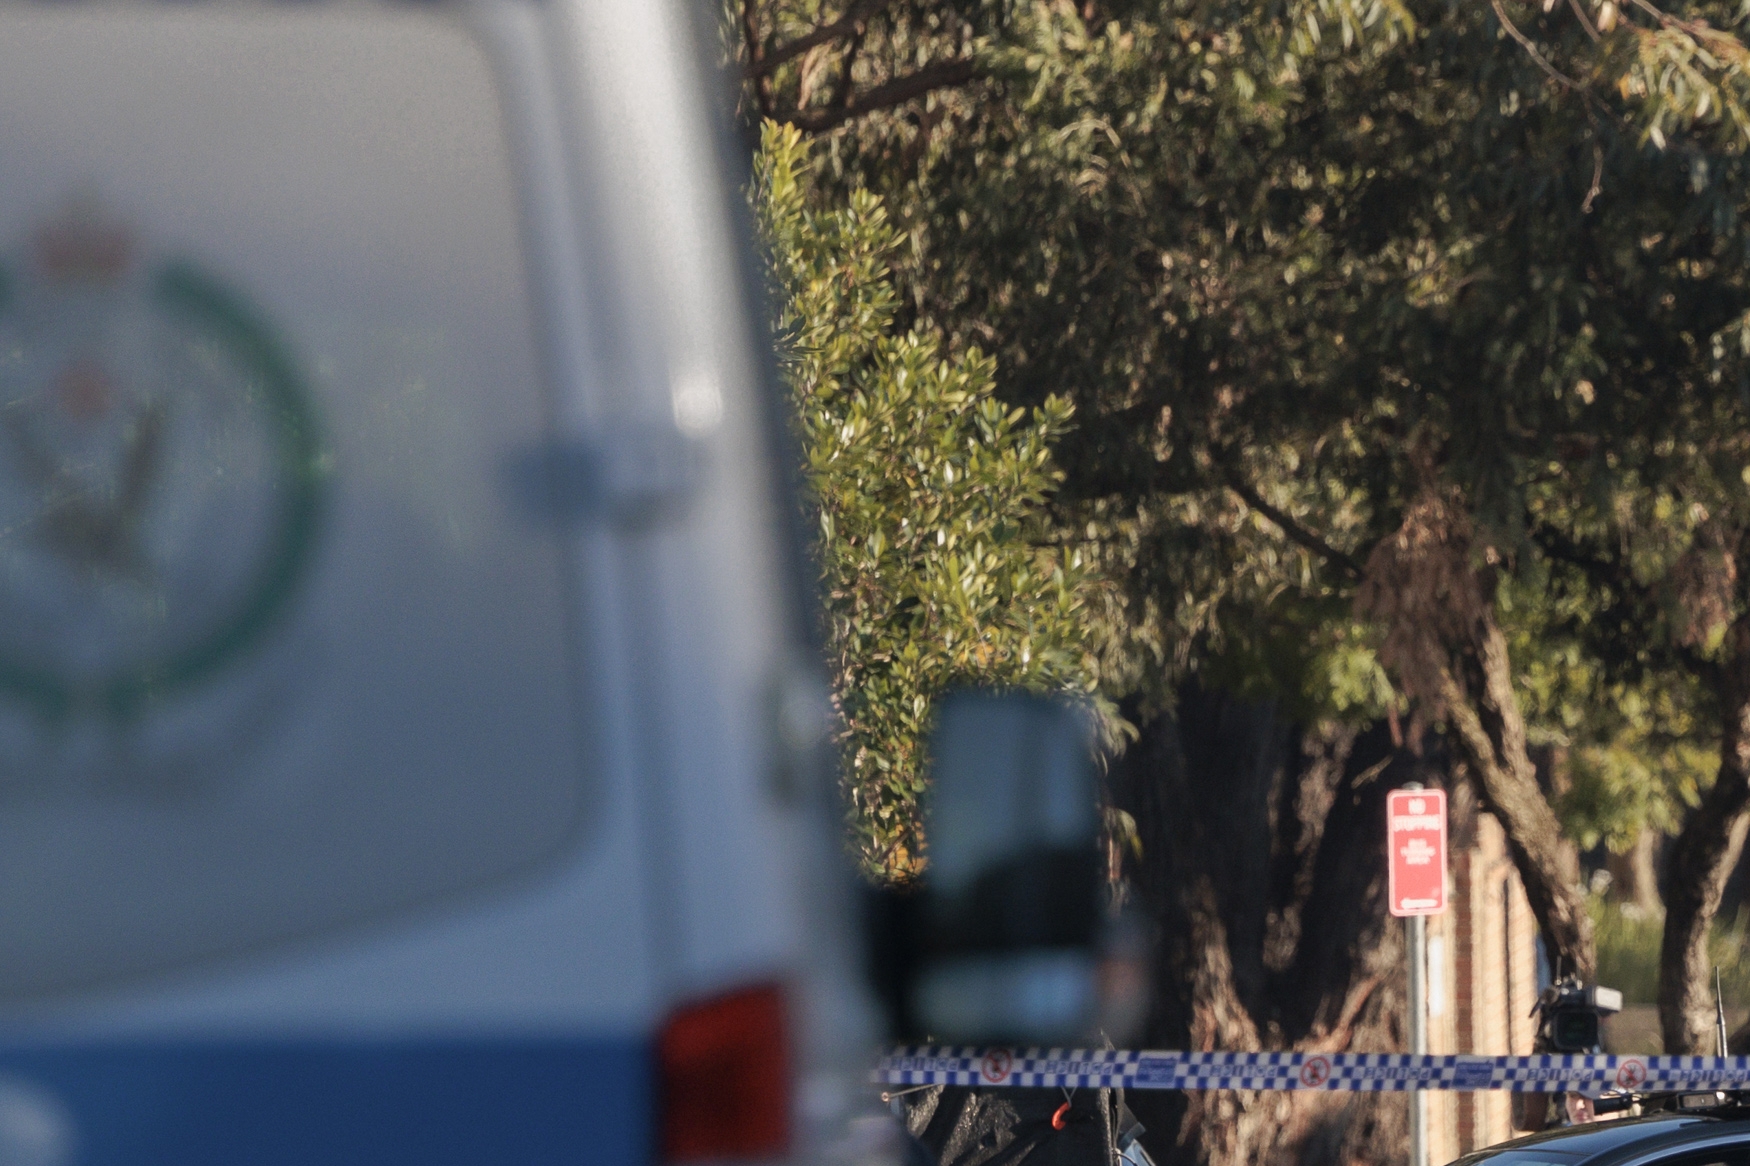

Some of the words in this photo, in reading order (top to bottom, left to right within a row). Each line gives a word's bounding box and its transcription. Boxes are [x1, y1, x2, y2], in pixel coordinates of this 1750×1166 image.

[1209, 1065, 1277, 1078] POLICE
[1364, 1066, 1432, 1079] POLICE
[1527, 1068, 1595, 1081] POLICE
